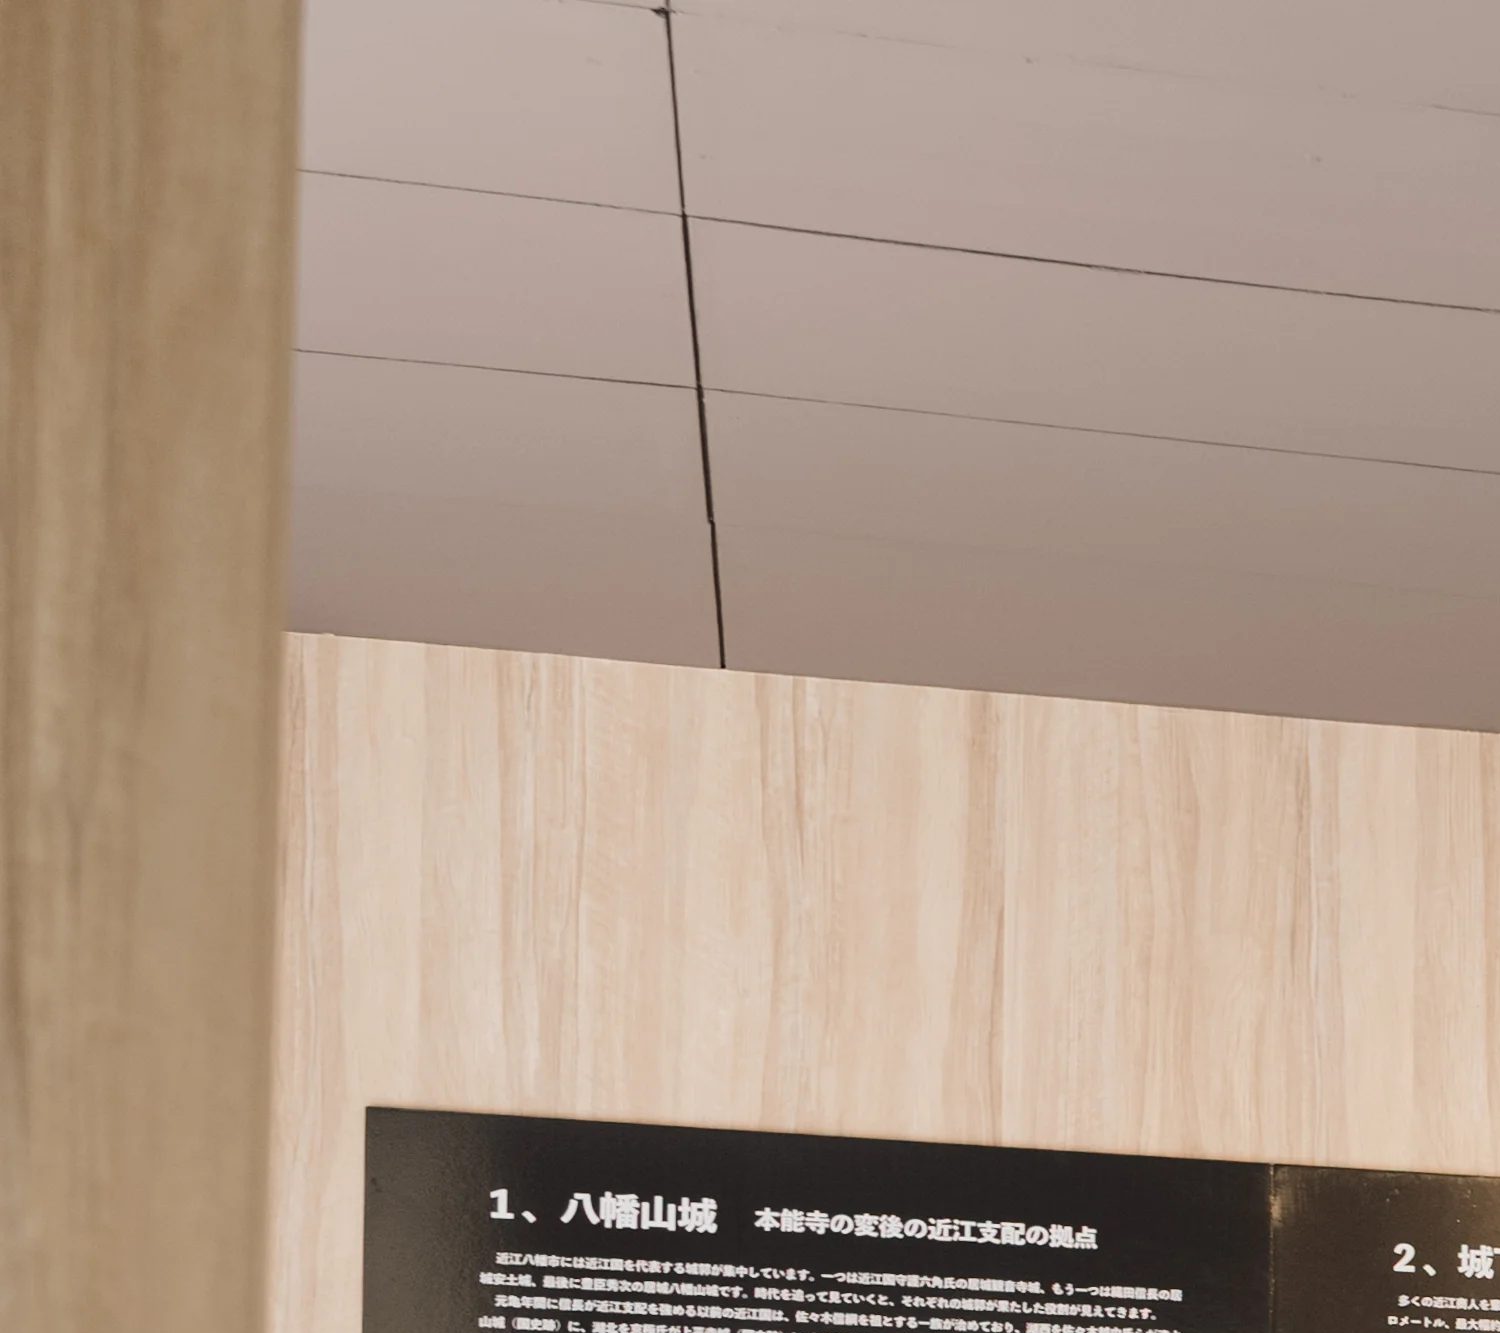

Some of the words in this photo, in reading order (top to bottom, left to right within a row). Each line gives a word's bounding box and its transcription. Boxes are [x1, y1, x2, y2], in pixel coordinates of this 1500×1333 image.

[488, 1185, 718, 1234] 1、八幡山城
[754, 1207, 1098, 1249] 本能寺の変後の近江支配の拠点
